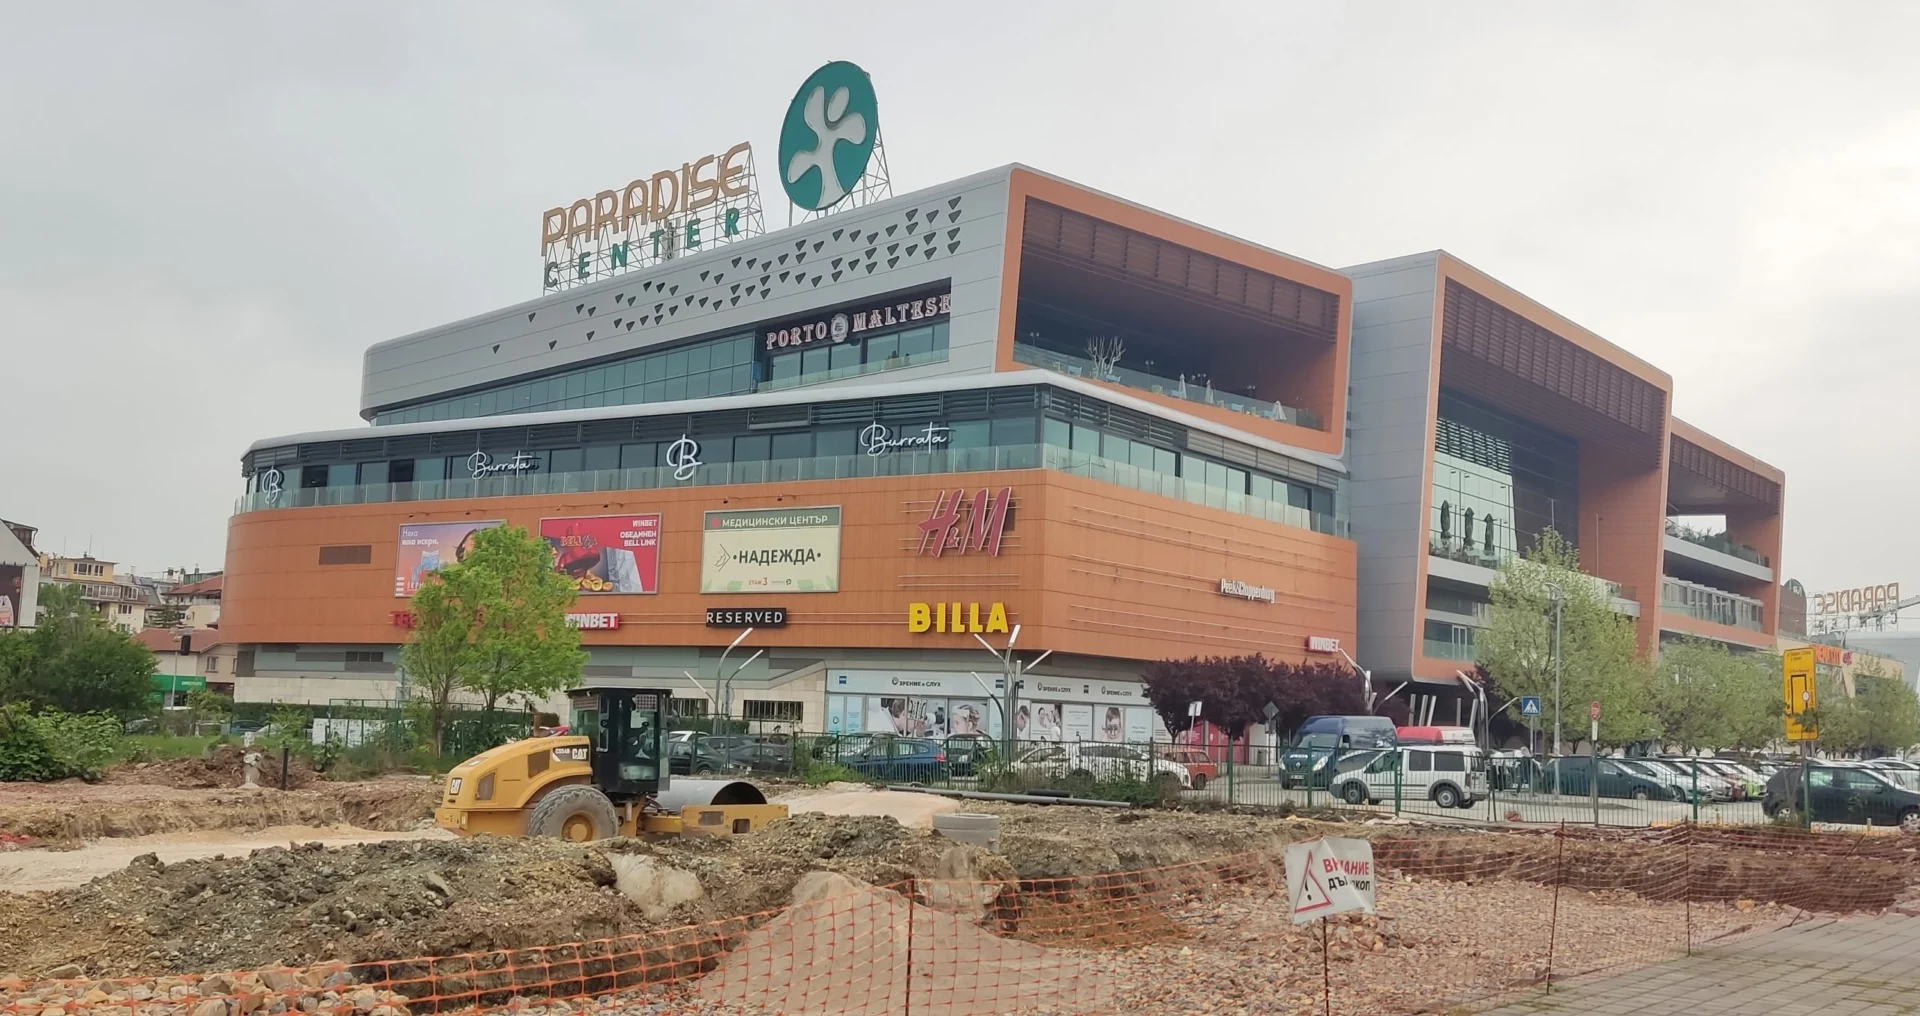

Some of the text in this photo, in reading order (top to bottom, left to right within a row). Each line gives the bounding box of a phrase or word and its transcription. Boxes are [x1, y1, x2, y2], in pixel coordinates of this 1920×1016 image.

[541, 141, 750, 256] PARADISE
[545, 208, 740, 287] CENTER
[766, 321, 827, 350] PORTO
[852, 293, 952, 332] MALTESE
[860, 420, 950, 457] Burrata
[467, 448, 533, 480] Burrata
[633, 519, 657, 528] WINBET
[722, 515, 828, 528] МЕДИЦИНСКИ ЦЕНТЪР
[917, 487, 1012, 558] H&M
[620, 531, 657, 539] ОБЕДИНЕН
[739, 548, 816, 567] НАДЕЖДА
[706, 611, 783, 624] RESERVED
[908, 602, 1009, 633] BILLA
[1309, 636, 1340, 652] WINBET
[572, 748, 588, 760] CAT
[451, 779, 462, 794] CAT
